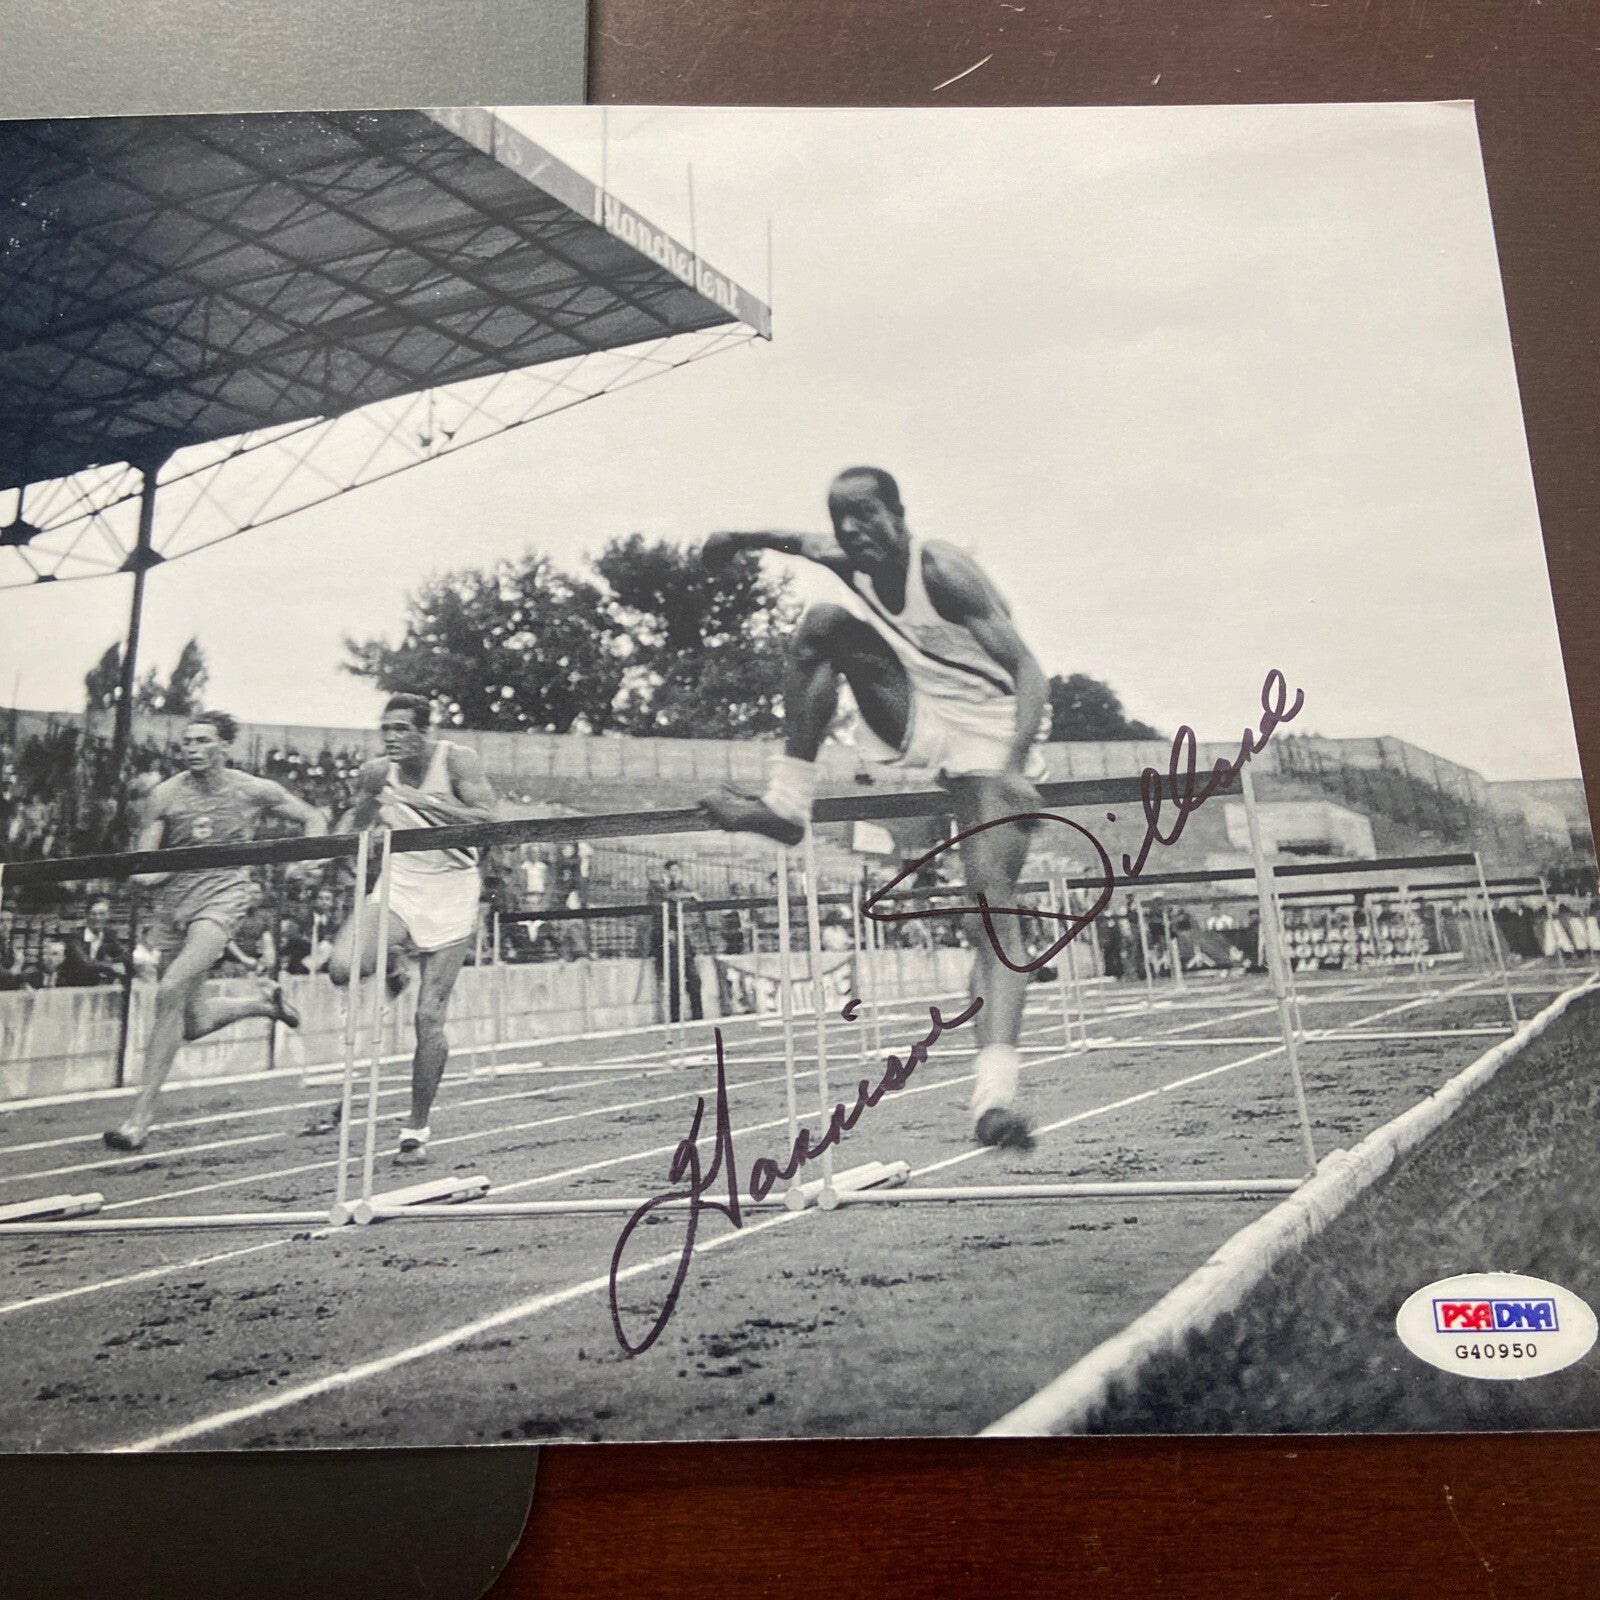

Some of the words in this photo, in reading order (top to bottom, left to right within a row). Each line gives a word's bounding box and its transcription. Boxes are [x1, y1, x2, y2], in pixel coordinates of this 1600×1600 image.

[860, 668, 1305, 974] Dillard
[1440, 1303, 1493, 1330] PSA
[1494, 1302, 1553, 1330] DNA
[1455, 1343, 1538, 1360] G40950
